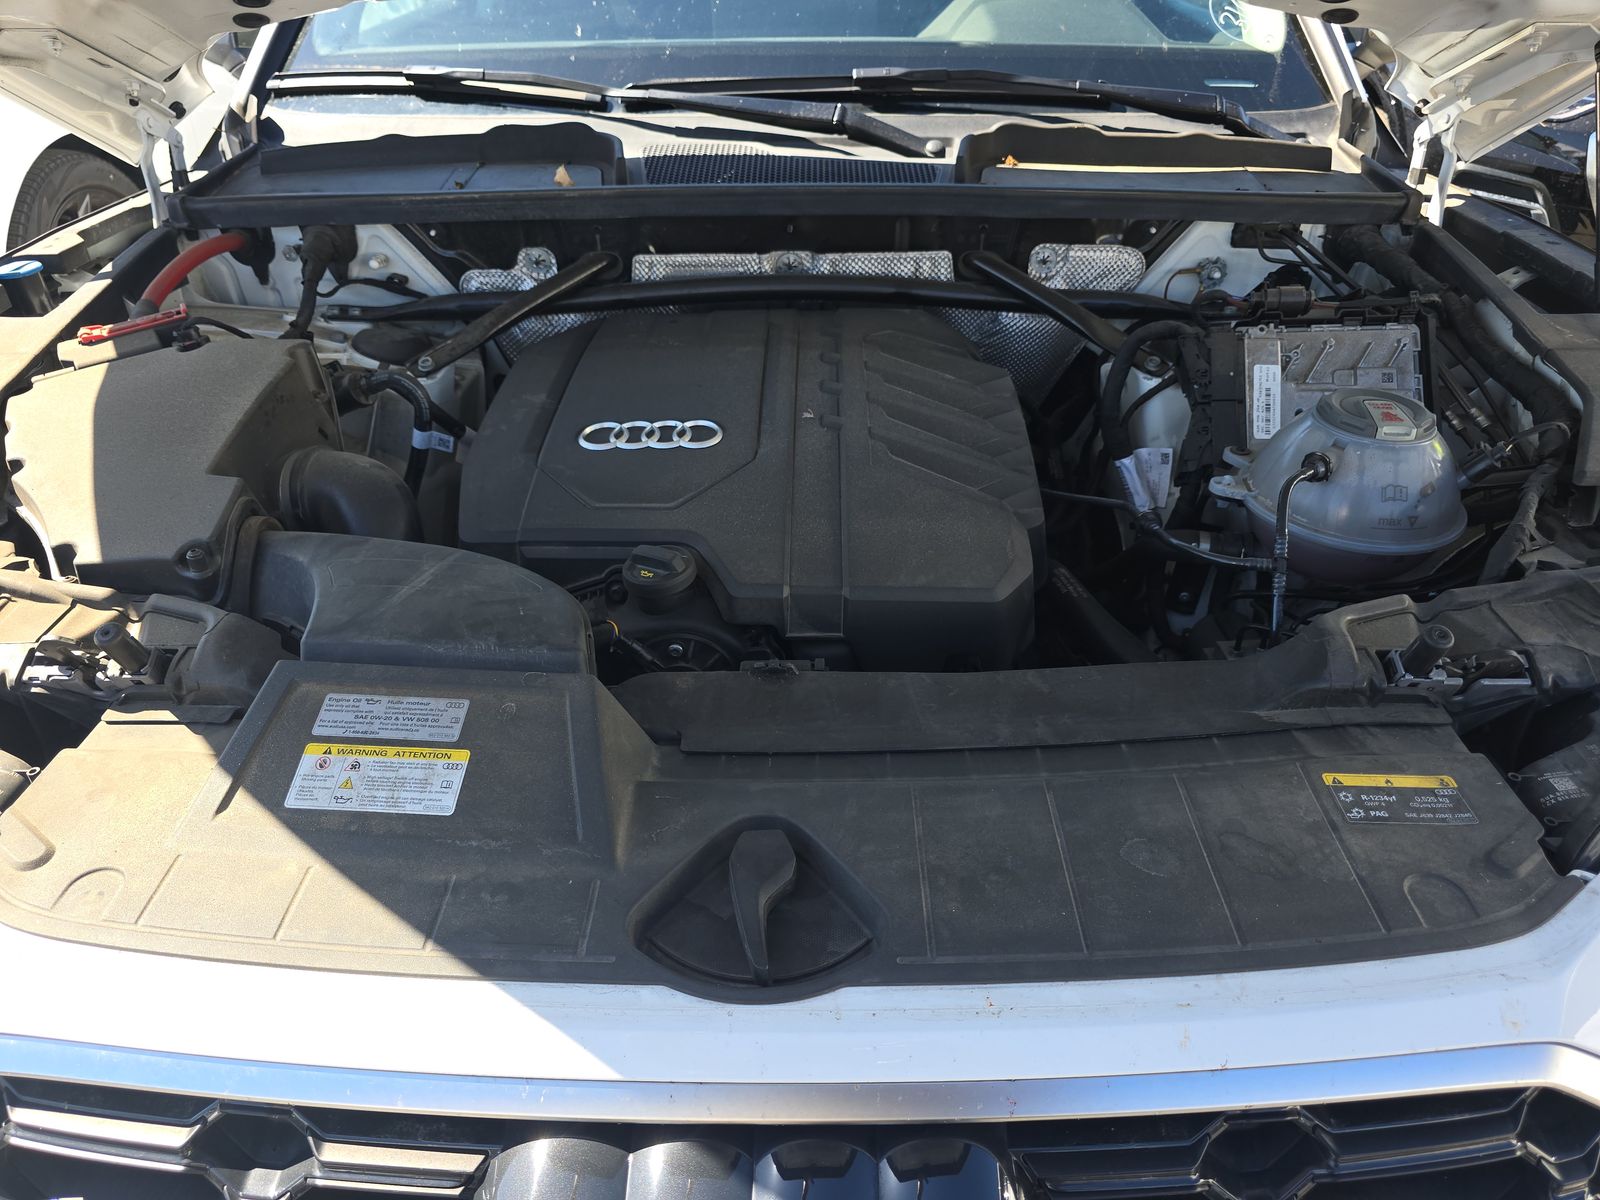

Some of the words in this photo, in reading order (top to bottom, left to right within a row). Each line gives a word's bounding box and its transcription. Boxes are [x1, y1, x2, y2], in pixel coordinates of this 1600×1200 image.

[1377, 517, 1402, 526] max
[336, 748, 388, 757] WARNING
[393, 750, 452, 760] ATTENTION
